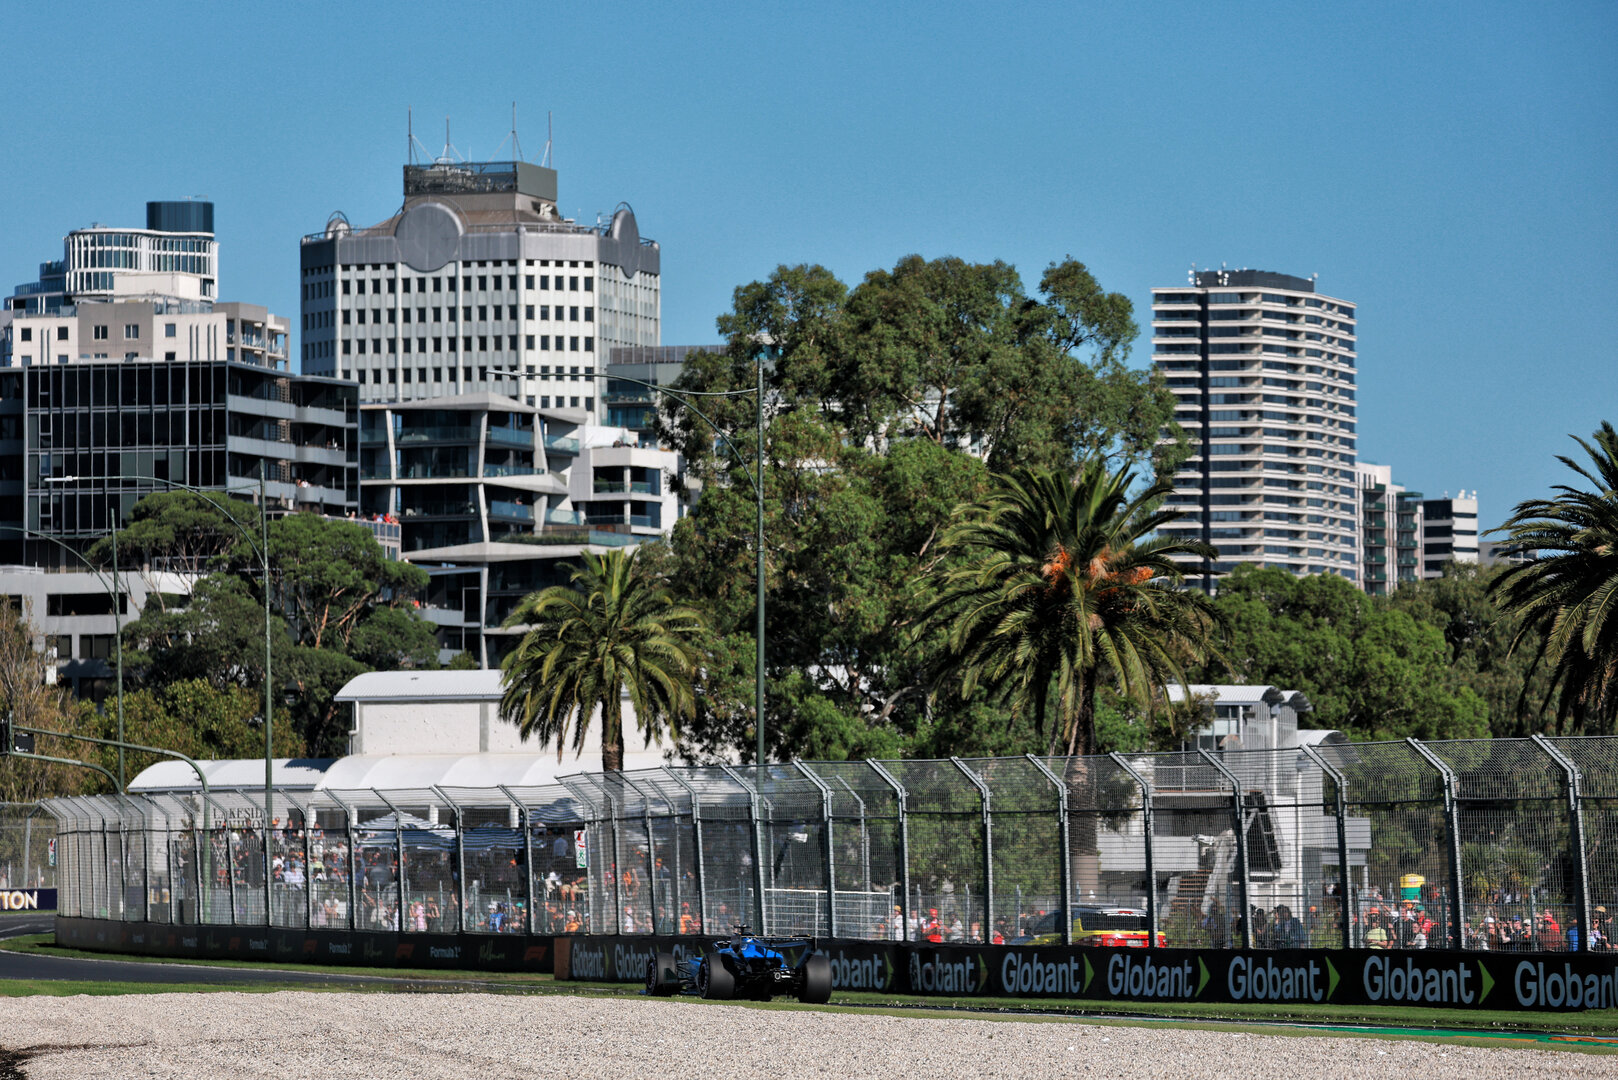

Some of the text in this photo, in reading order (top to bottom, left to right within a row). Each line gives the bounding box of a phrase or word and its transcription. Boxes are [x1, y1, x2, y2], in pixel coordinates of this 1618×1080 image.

[213, 807, 264, 819] LKESID
[0, 890, 38, 910] TON
[430, 946, 454, 960] Formula
[572, 943, 604, 978] Globant
[815, 949, 884, 989] obant
[1001, 952, 1081, 994] Globant
[1107, 953, 1193, 998] Globant
[1228, 955, 1323, 1001] Globant
[1363, 955, 1475, 1005] Globant
[1514, 960, 1618, 1009] Globan
